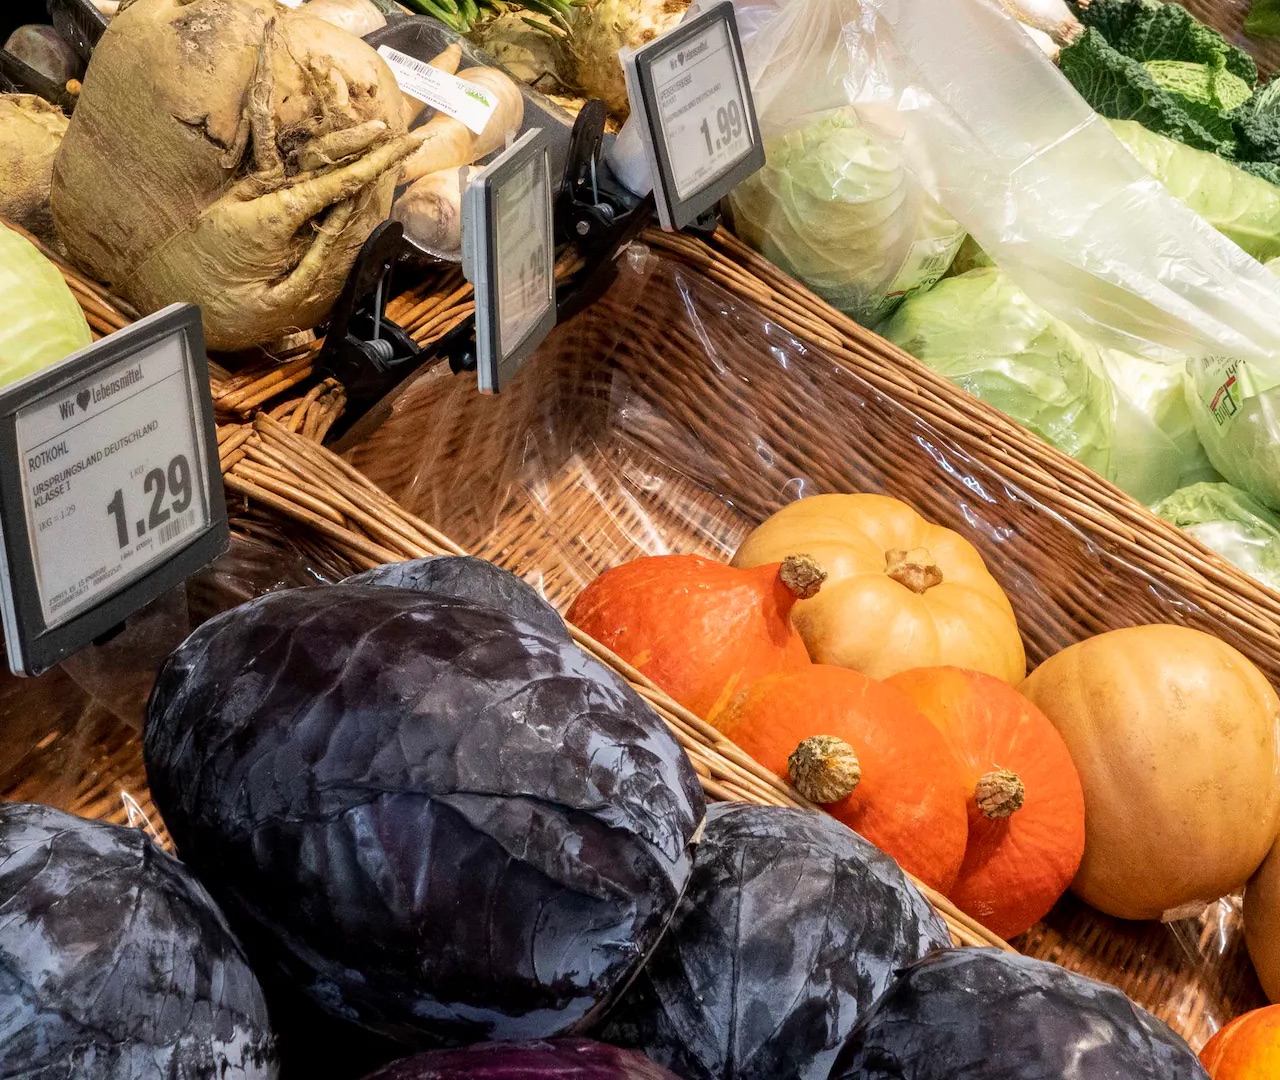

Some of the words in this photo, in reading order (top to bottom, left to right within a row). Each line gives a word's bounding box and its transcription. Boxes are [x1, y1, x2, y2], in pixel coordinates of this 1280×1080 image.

[700, 99, 742, 157] 1.99
[59, 400, 75, 420] Wir
[92, 364, 145, 404] Lebensmittel.
[28, 441, 69, 473] ROTKOHL
[32, 450, 103, 496] URSPRUNGSLAND
[104, 420, 159, 458] DEUTSCHLAND
[34, 485, 64, 509] KLASSE
[39, 516, 53, 531] 1KG
[60, 505, 76, 520] 1.29
[107, 453, 193, 550] 1.29
